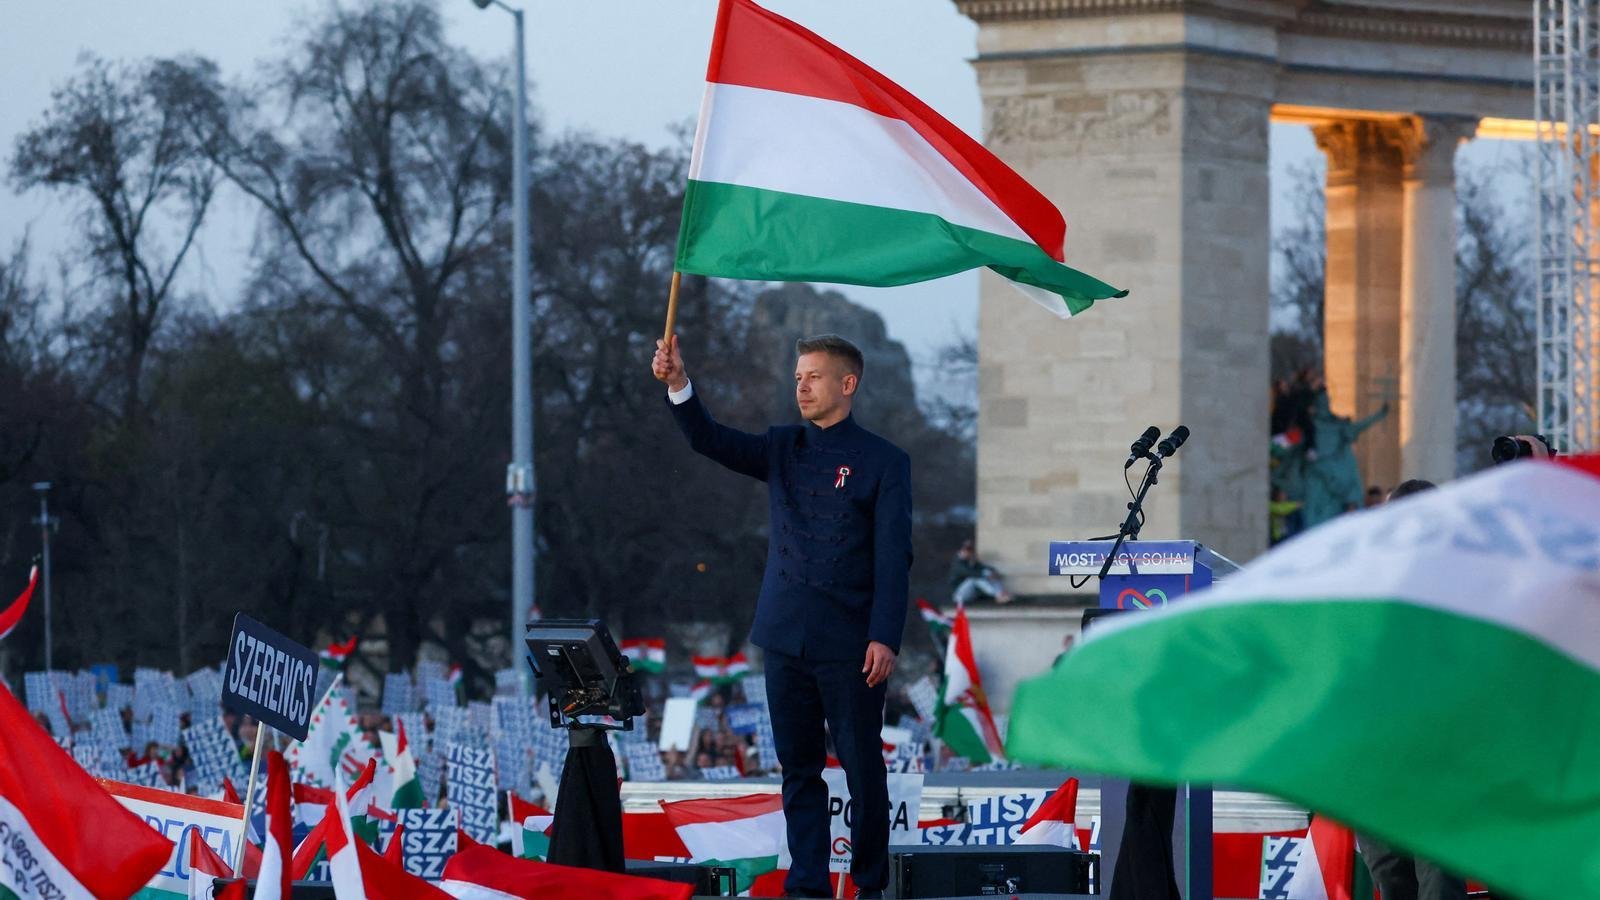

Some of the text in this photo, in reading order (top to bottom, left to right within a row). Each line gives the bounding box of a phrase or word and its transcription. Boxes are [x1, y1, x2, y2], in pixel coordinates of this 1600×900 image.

[1055, 553, 1096, 566] MOST
[1142, 552, 1187, 566] SOHA!
[229, 630, 313, 727] SZERENCS
[447, 742, 495, 770] TISZA
[447, 761, 496, 790] TISZA
[447, 780, 498, 810] TISZA
[969, 790, 1047, 826] TISZ
